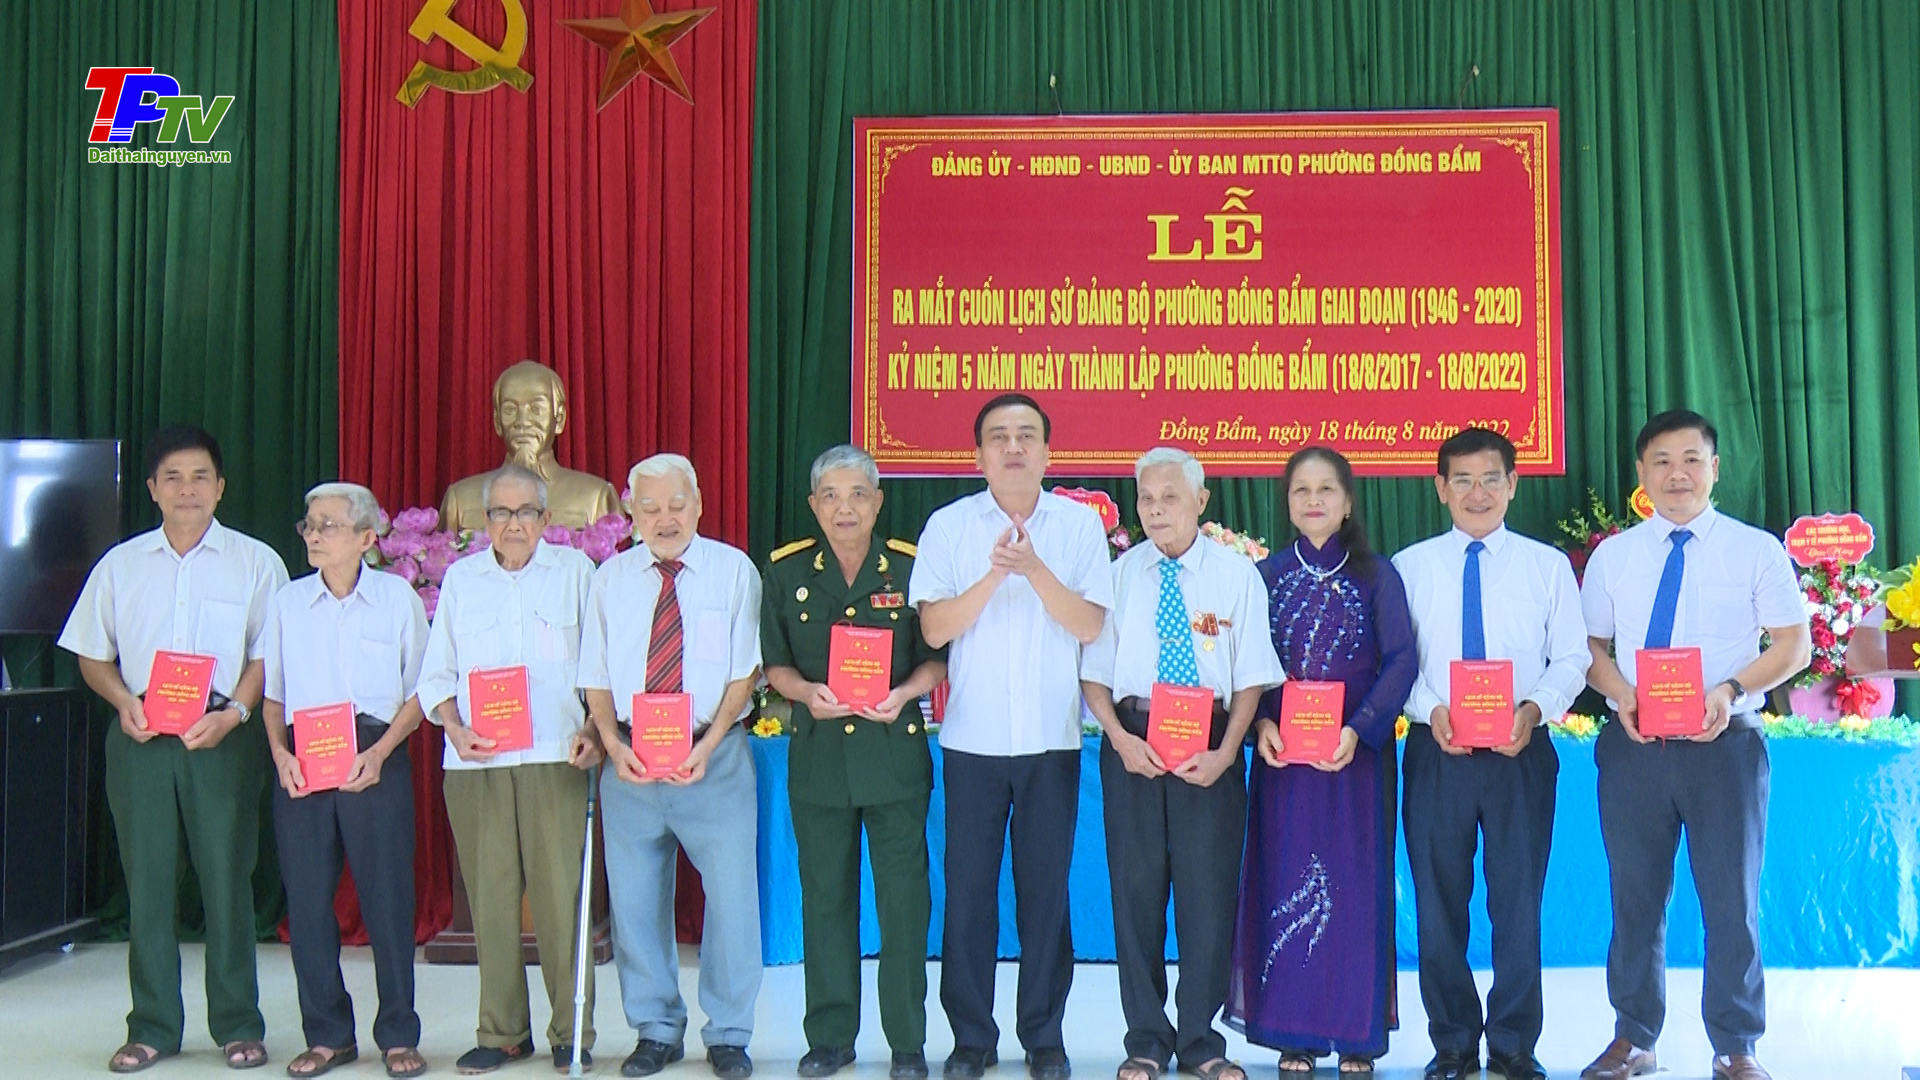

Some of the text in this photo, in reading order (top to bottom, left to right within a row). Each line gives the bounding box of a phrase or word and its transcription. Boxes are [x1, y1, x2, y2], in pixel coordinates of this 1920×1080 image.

[931, 150, 983, 176] ĐẢNG
[989, 149, 1011, 175] ỦY
[1030, 155, 1081, 175] HĐND
[1099, 155, 1151, 175] UBND
[1169, 148, 1193, 175] ỦY
[1198, 155, 1237, 175] BAN
[1243, 154, 1293, 176] MTTQ
[1299, 149, 1375, 174] PHƯỜNG
[1380, 146, 1433, 173] ĐỒNG
[1438, 144, 1481, 172] BẨM
[1147, 186, 1263, 261] LỄ
[892, 288, 914, 325] RA
[919, 276, 954, 325] MẮT
[959, 276, 1004, 326] CUỐN
[1009, 288, 1046, 334] LỊCH
[1050, 276, 1075, 325] SỬ
[1077, 276, 1123, 325] ĐẢNG
[1127, 281, 1150, 334] BỘ
[1155, 279, 1223, 326] PHƯỜNG
[1227, 276, 1273, 326] ĐỒNG
[1278, 273, 1316, 325] BẨM
[1321, 287, 1355, 326] GIAI
[1359, 287, 1406, 333] ĐOẠN
[1411, 287, 1459, 328] (1946
[1474, 286, 1522, 328] 2020)
[887, 341, 909, 390] KỶ
[914, 345, 957, 398] NIỆM
[961, 353, 973, 390] 5
[976, 345, 1016, 390] NĂM
[1020, 345, 1066, 390] NGÀY
[1070, 345, 1125, 390] THÀNH
[1129, 345, 1160, 398] LẬP
[1164, 344, 1234, 391] PHƯỜNG
[1237, 341, 1285, 391] ĐỒNG
[1288, 338, 1328, 391] BẨM
[1332, 352, 1421, 394] (18/8/2017
[1437, 352, 1527, 394] 18/8/2022)
[1159, 417, 1210, 446] Đồng
[1215, 415, 1262, 443] Bẩm,
[1268, 419, 1312, 446] ngày
[1318, 421, 1340, 441] 18
[1344, 419, 1398, 446] tháng
[1402, 420, 1414, 441] 8
[1418, 420, 1460, 441] năm
